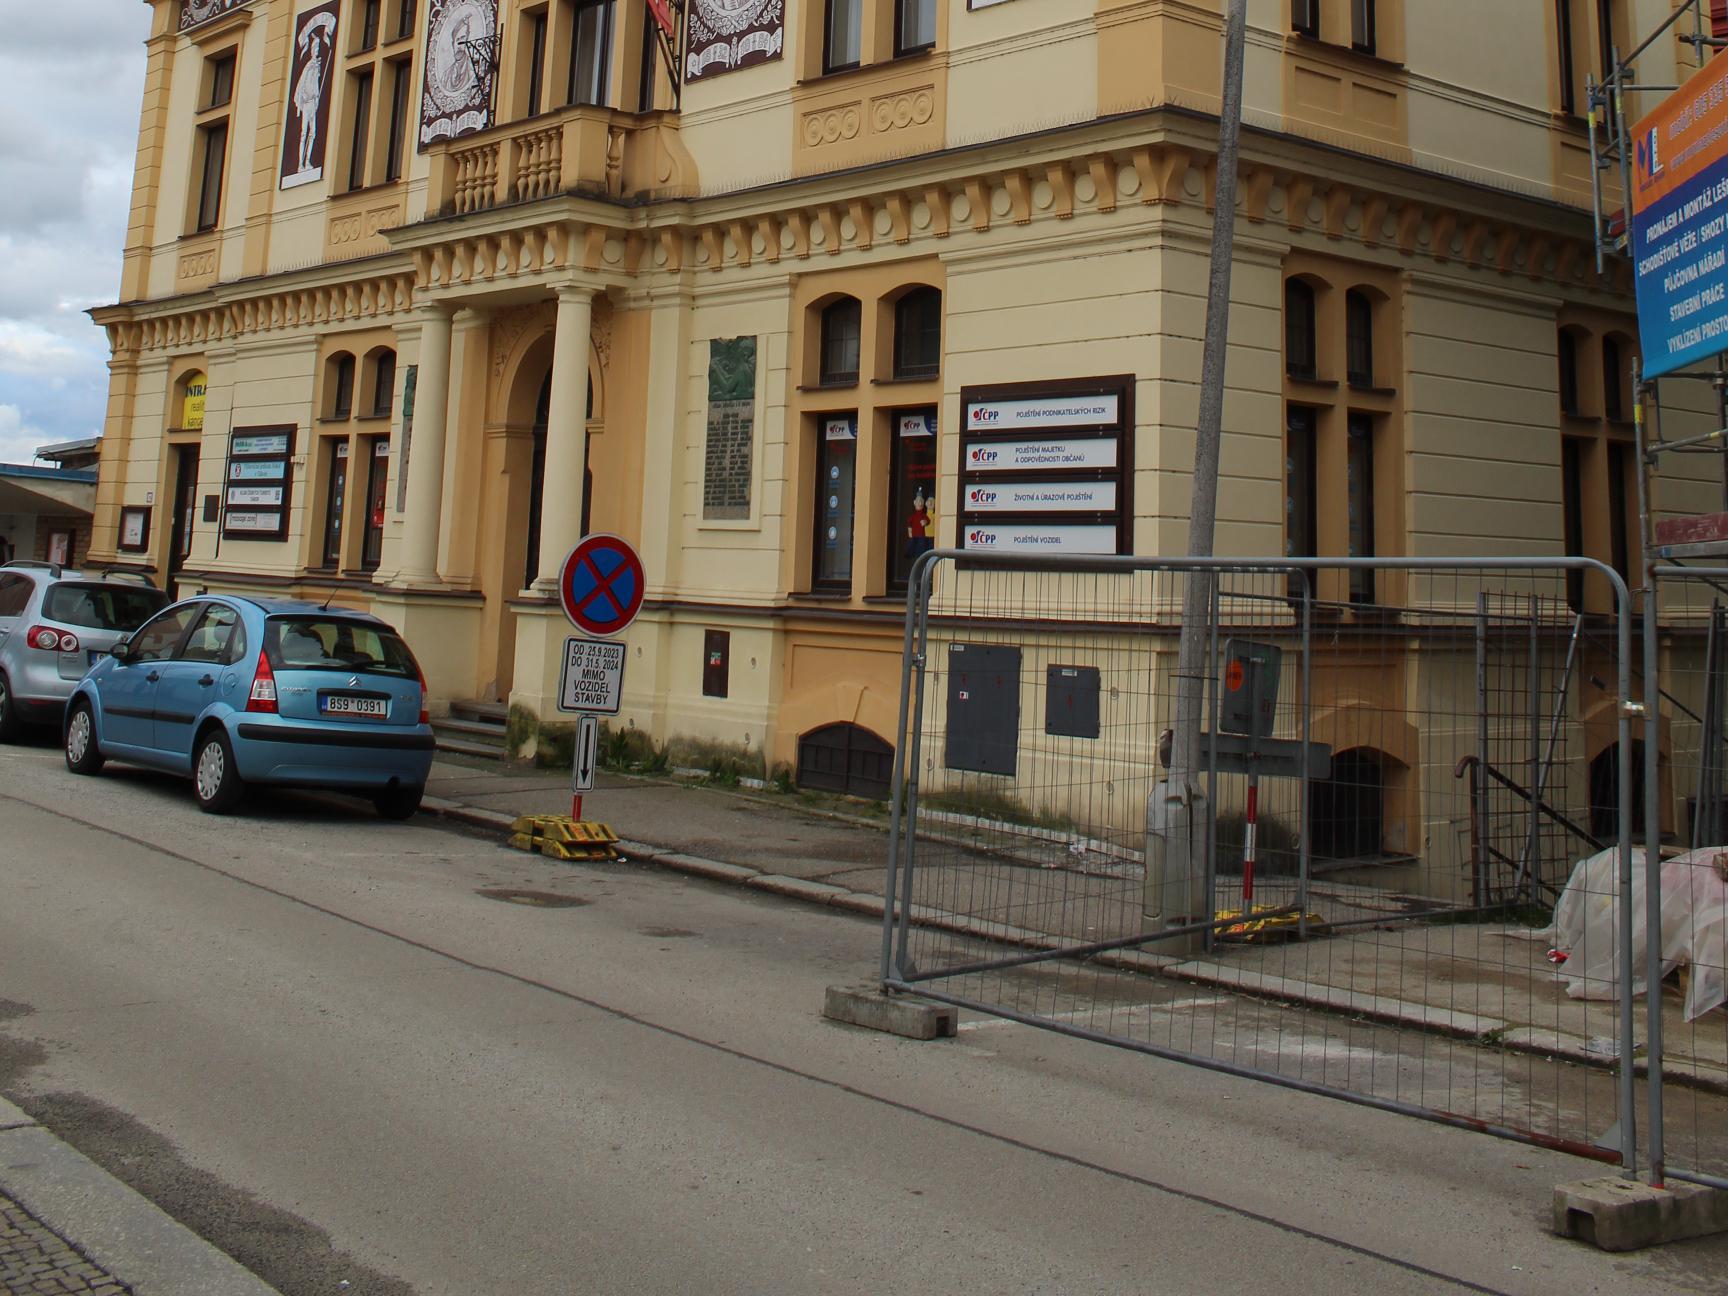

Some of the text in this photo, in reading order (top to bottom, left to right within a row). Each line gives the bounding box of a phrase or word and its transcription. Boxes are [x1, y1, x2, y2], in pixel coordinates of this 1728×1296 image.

[1646, 211, 1678, 244] PRONÁJEM
[1678, 208, 1683, 224] A
[1684, 187, 1713, 220] MONTÁŽ
[1679, 230, 1697, 254] VĚŽE
[1701, 215, 1724, 242] SHOZY
[1664, 245, 1725, 294] PŮJČOVNA NÁŘADÍ
[1669, 282, 1725, 321] STAVEBNÍ PRÁCE
[1667, 323, 1701, 353] VYKLÍZENÍ
[1016, 409, 1041, 419] POJIŠTĚNÍ
[1042, 406, 1092, 417] PODNIKATELSKÝCH
[1015, 445, 1040, 454] POJIŠTĚNÍ
[1020, 454, 1061, 463] ODPOVĚDNOSTI
[1061, 453, 1085, 462] OBČANŮ
[1014, 493, 1035, 501] ŽIVOTNÍ
[1040, 492, 1065, 501] ÚRAZOVÉ
[1066, 492, 1093, 501] POJIŠTĚNÍ
[1014, 535, 1039, 544] POJIŠTĚNÍ
[1040, 536, 1062, 544] VOZIDEL
[574, 644, 584, 655] OD
[571, 656, 582, 667] DO
[603, 660, 619, 671] 2024
[581, 669, 606, 682] MIMO
[574, 680, 610, 693] VOZIDEL
[574, 692, 608, 704] STAVBY
[330, 698, 349, 710] 8S9
[357, 701, 382, 713] 0391
